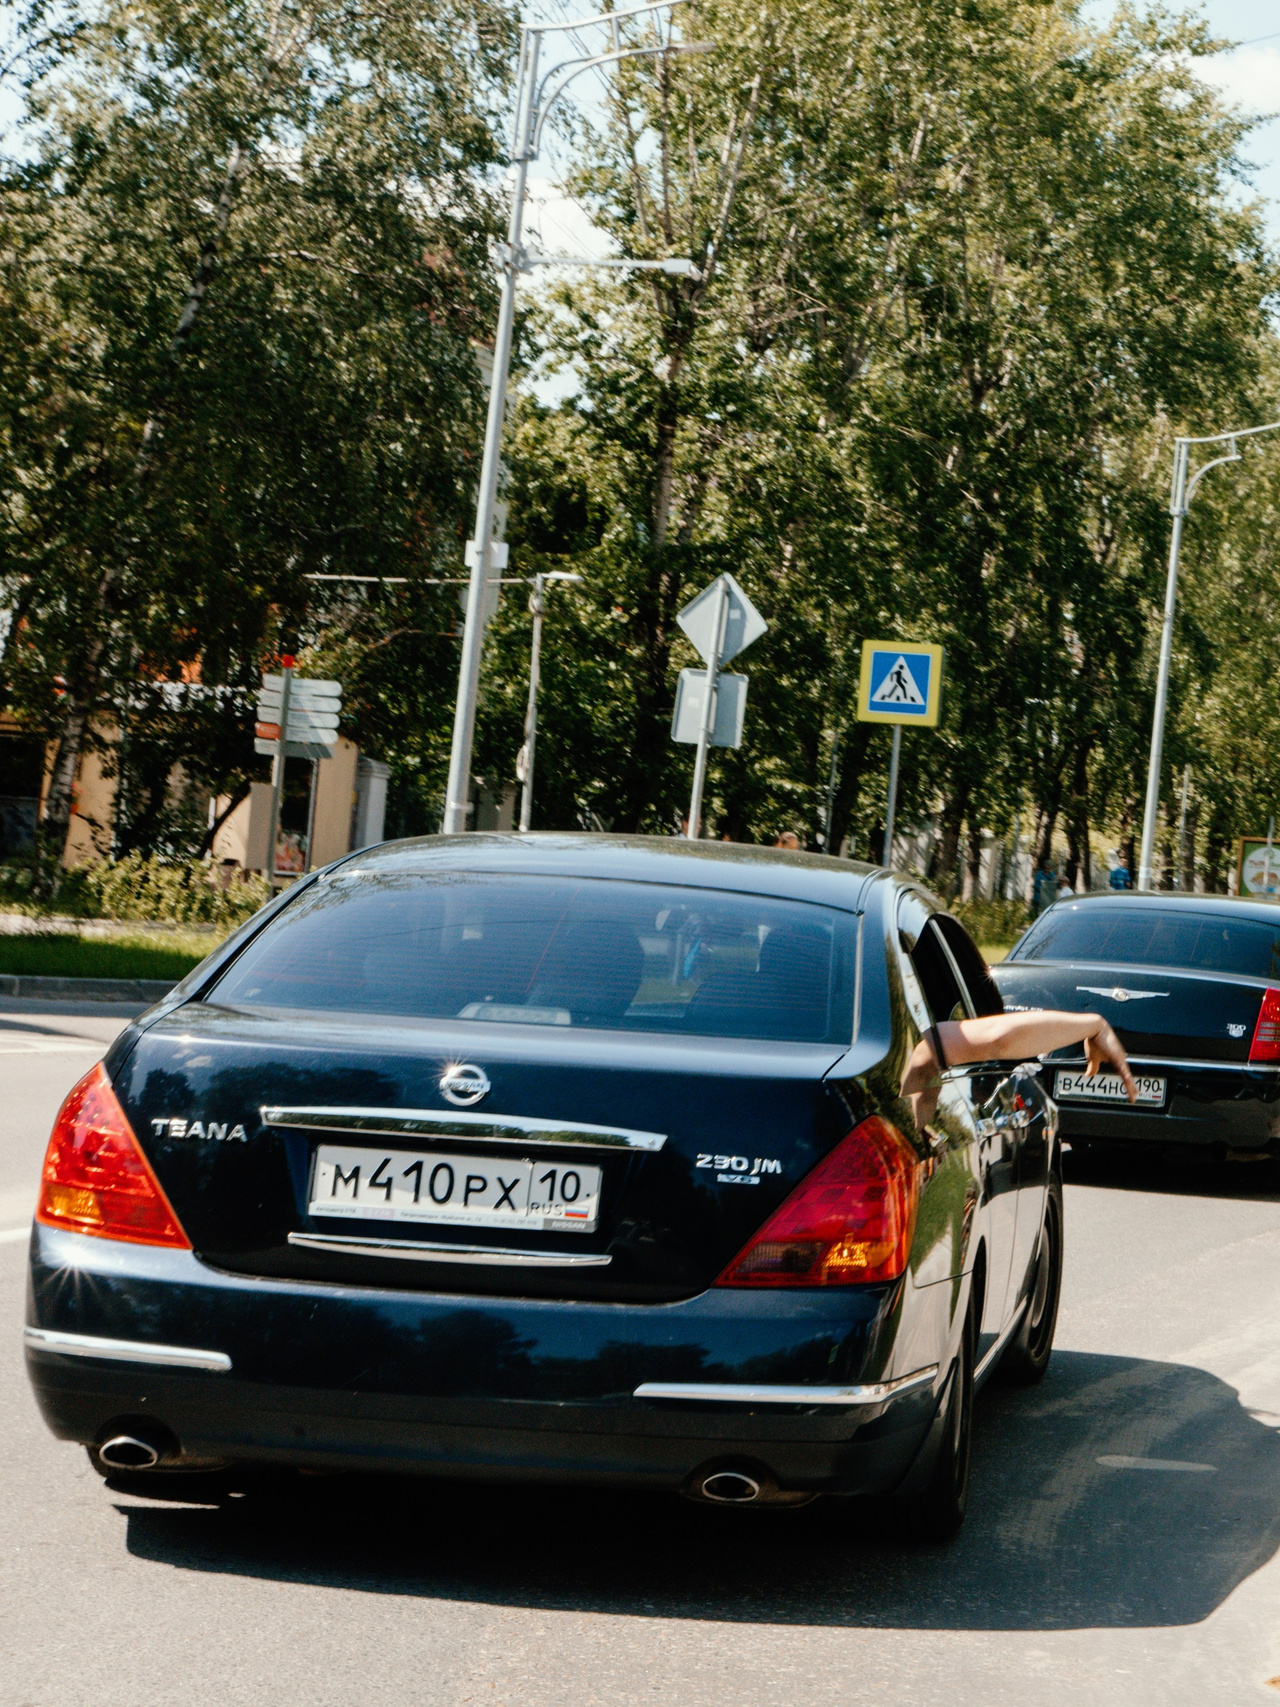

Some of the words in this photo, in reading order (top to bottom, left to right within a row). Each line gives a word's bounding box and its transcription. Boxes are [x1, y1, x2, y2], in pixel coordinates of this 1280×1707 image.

[1135, 1079, 1160, 1093] 190
[151, 1118, 248, 1143] TEANA
[330, 1158, 521, 1211] М410РХ
[539, 1169, 581, 1203] 10
[530, 1202, 563, 1216] RUS
